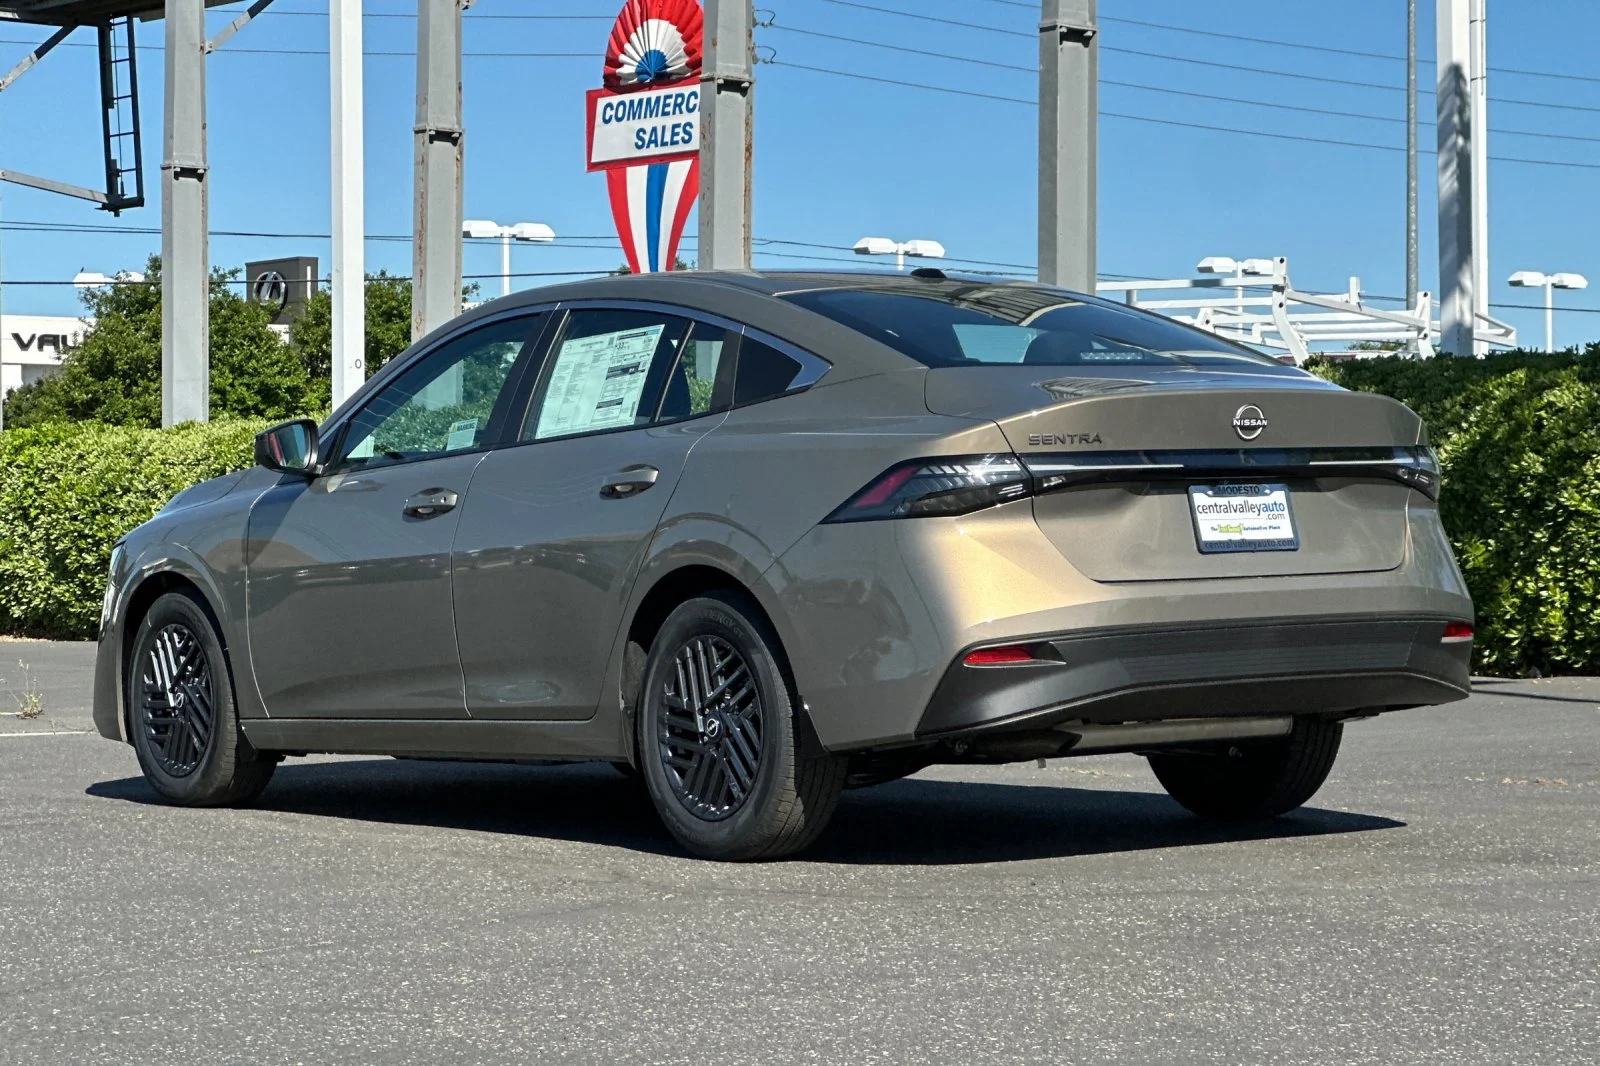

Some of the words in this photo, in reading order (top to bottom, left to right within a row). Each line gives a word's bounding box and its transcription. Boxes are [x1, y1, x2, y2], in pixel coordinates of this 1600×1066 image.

[602, 90, 700, 125] COMMERC
[634, 121, 694, 150] SALES
[11, 332, 82, 352] VAL
[1232, 418, 1268, 426] NISSAN
[1028, 433, 1103, 446] SENTRA
[1218, 485, 1260, 495] MODESTO
[1196, 500, 1286, 516] centralvalleyauto
[1265, 513, 1286, 521] .com
[1204, 538, 1295, 550] centralvalleyauto.com
